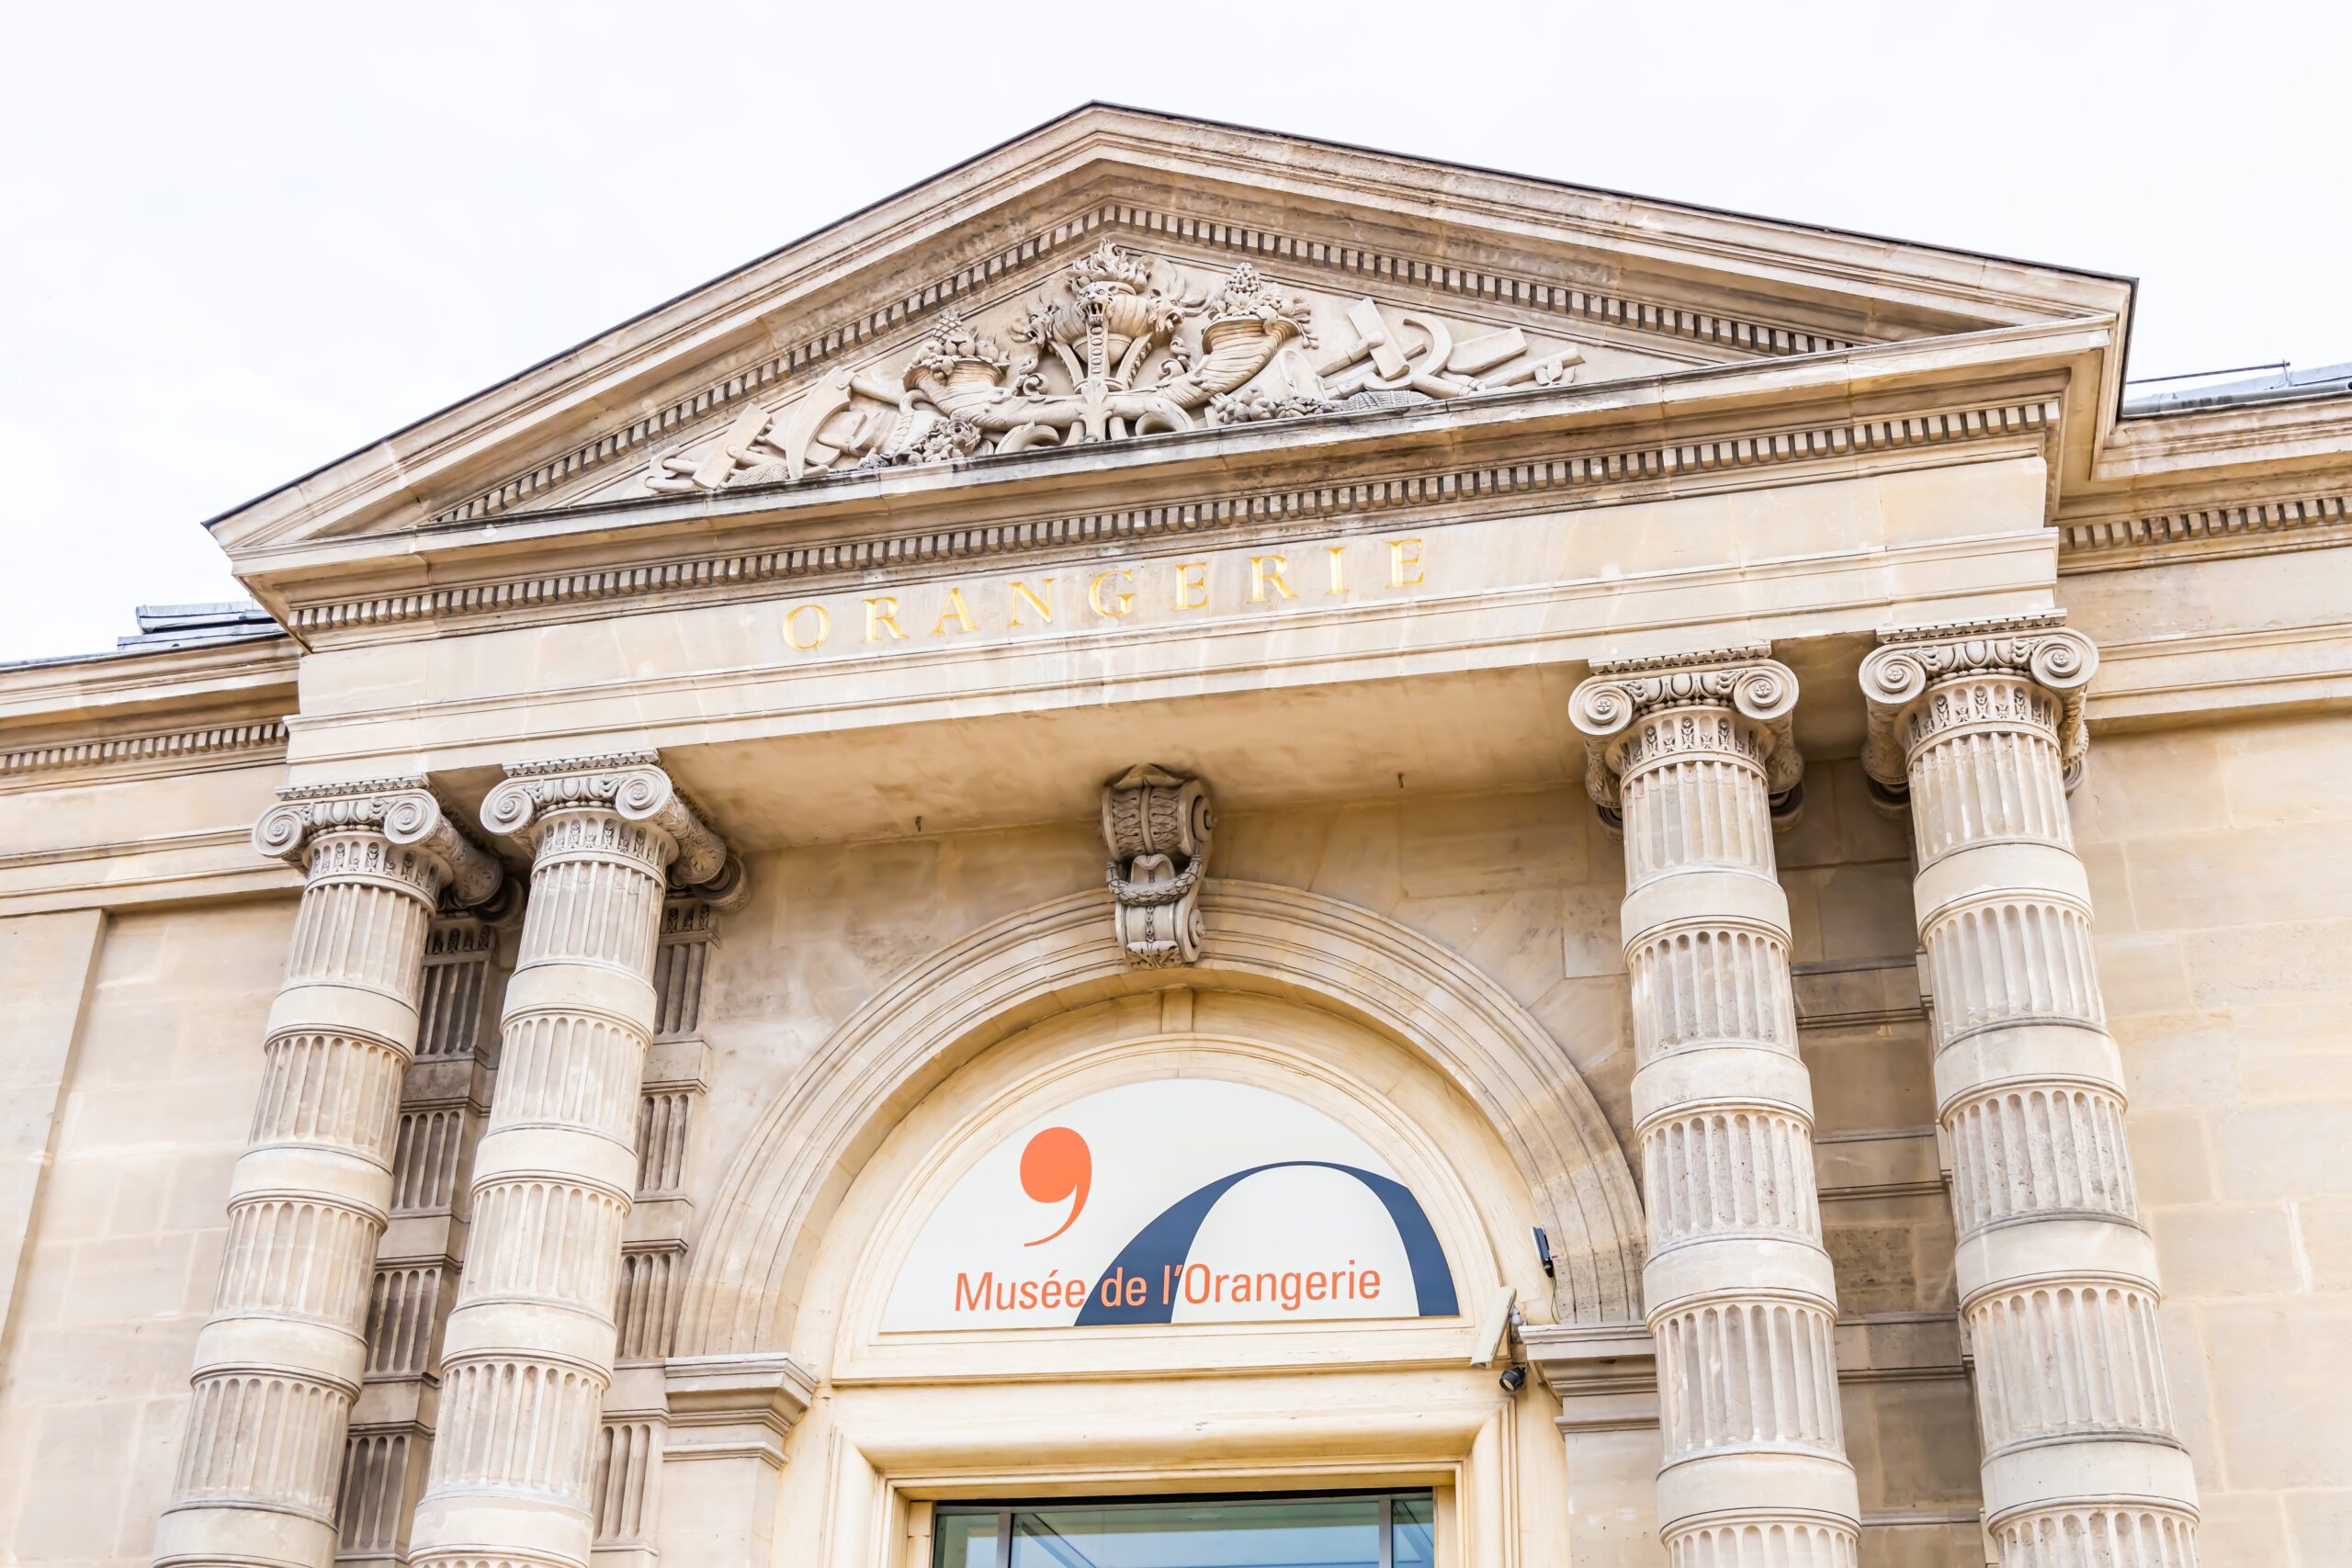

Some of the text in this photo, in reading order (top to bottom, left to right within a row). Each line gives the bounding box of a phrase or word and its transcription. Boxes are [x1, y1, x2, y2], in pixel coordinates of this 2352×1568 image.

[783, 538, 1424, 650] ORANGERIE
[956, 1259, 1381, 1311] Musée de l'Orangerie
